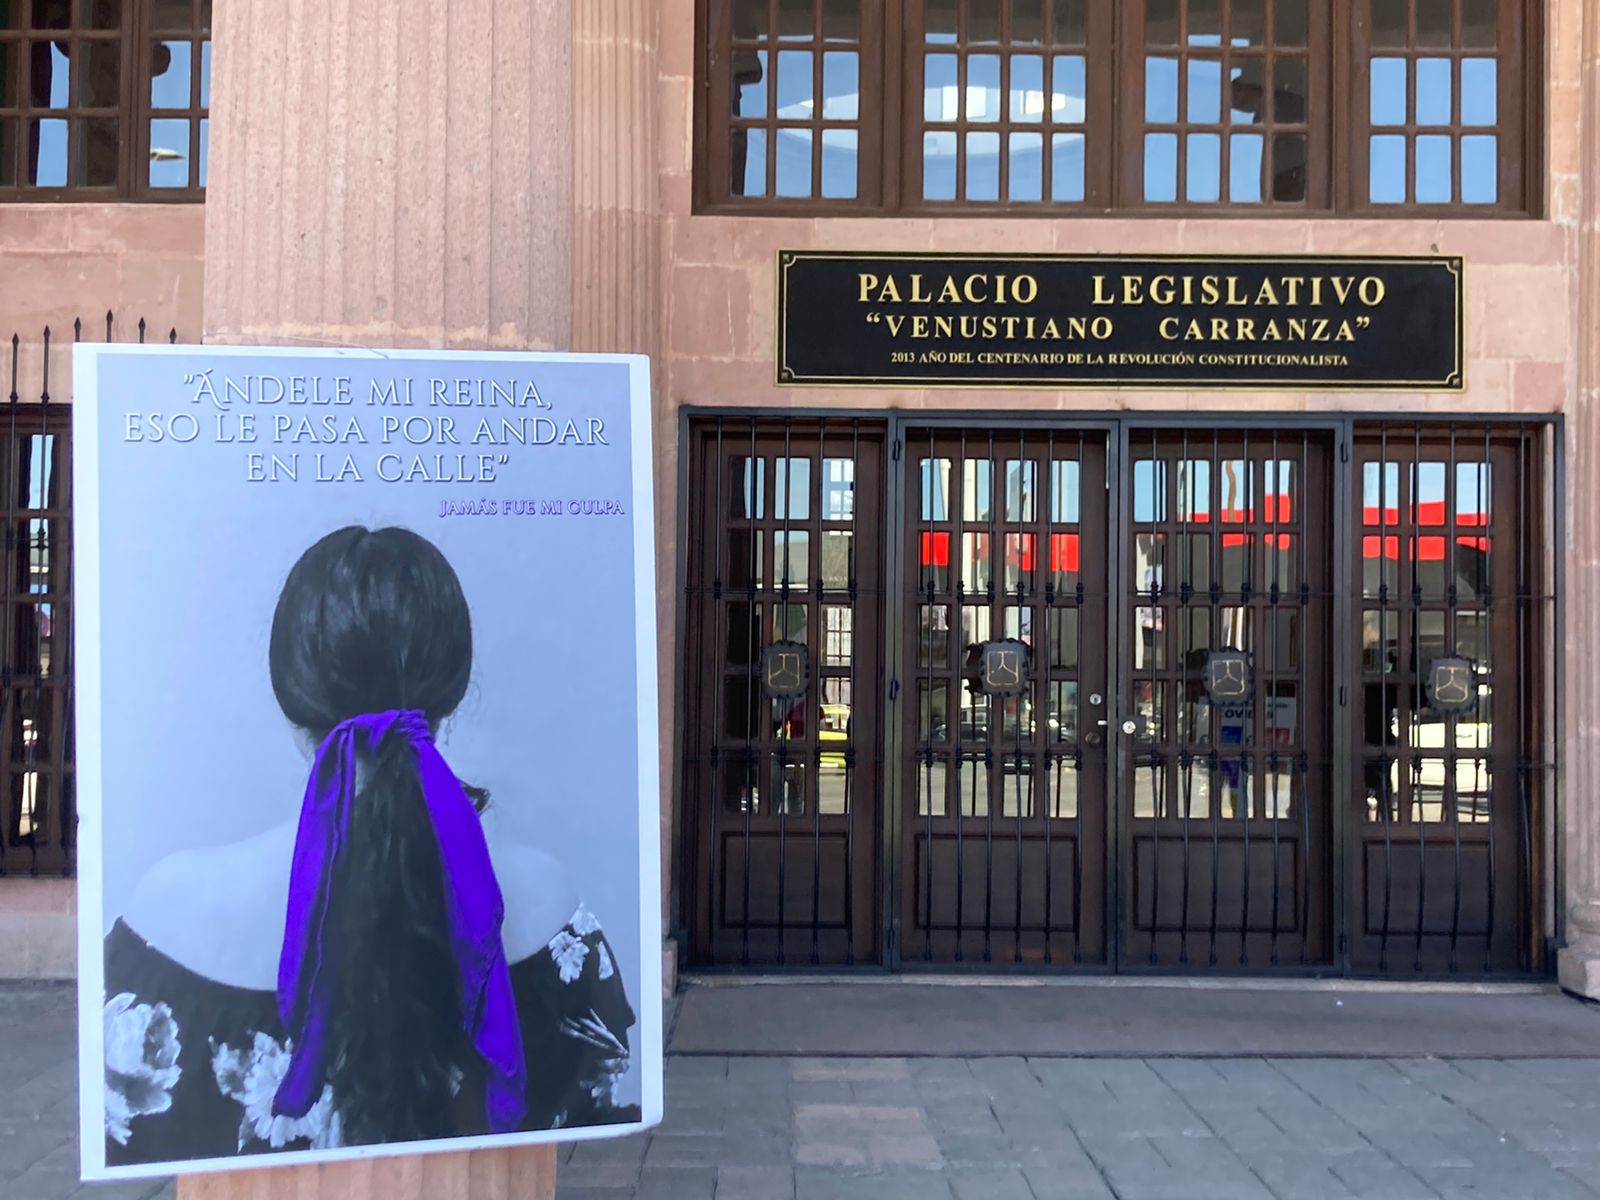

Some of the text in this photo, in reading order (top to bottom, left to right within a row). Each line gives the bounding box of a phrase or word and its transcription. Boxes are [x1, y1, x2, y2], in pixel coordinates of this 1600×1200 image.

[858, 273, 1386, 306] PALACIO LEGISLATIVO
[866, 312, 1371, 342] “VENUSTIANO CARRANZA”
[891, 350, 1349, 367] 2013 AÑO DEL CENTENARIO DE LA REVOLUCIÓN CONSTITUCIONALISTA
[366, 377, 414, 407] MI
[428, 378, 553, 410] REINA,
[123, 411, 610, 446] ESO LE PASA POR ANDAR
[246, 452, 510, 483] EN LA CALLE”
[439, 497, 625, 518] JAMÁS FUE MI CULPA
